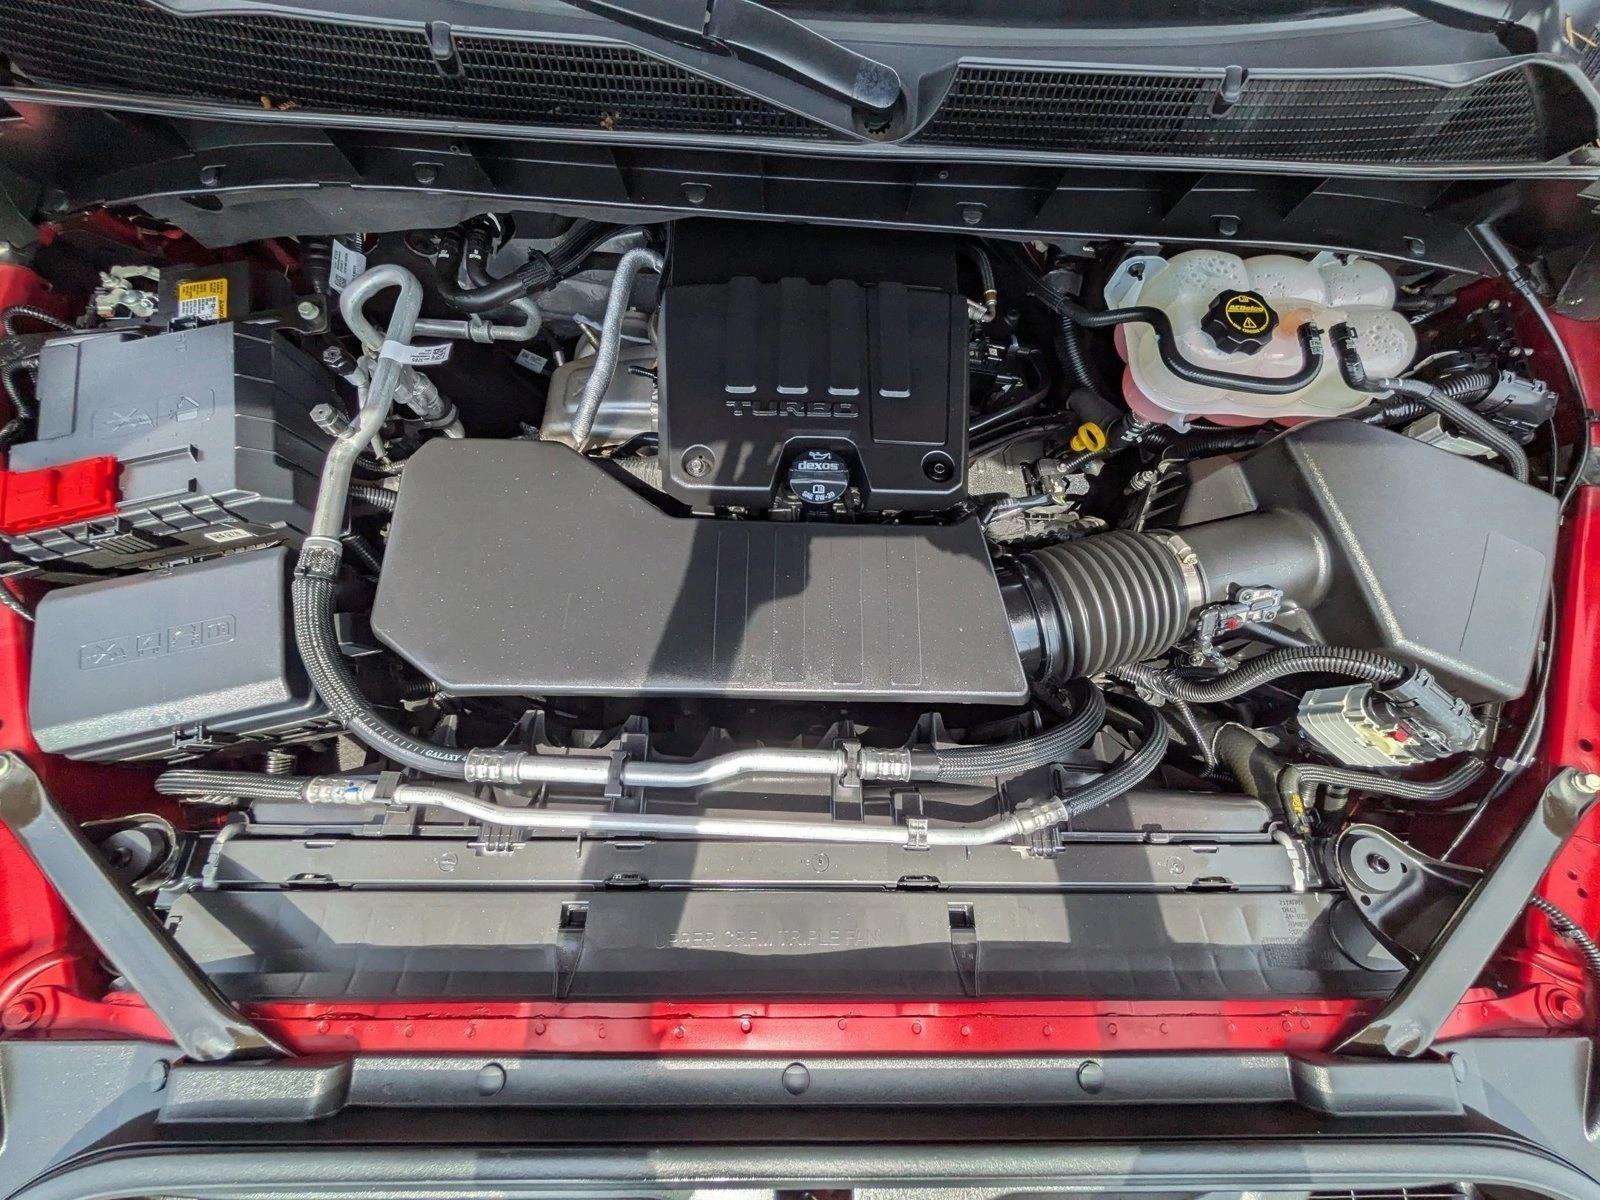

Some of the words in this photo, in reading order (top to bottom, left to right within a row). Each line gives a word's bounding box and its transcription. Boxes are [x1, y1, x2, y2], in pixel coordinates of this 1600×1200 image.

[1228, 304, 1265, 312] ACDelco
[725, 400, 860, 418] TURBO
[797, 460, 840, 471] dexos
[425, 748, 461, 762] GALAXY
[655, 930, 716, 949] UPPER
[777, 929, 841, 946] TRIPLE
[846, 929, 881, 946] FAN
